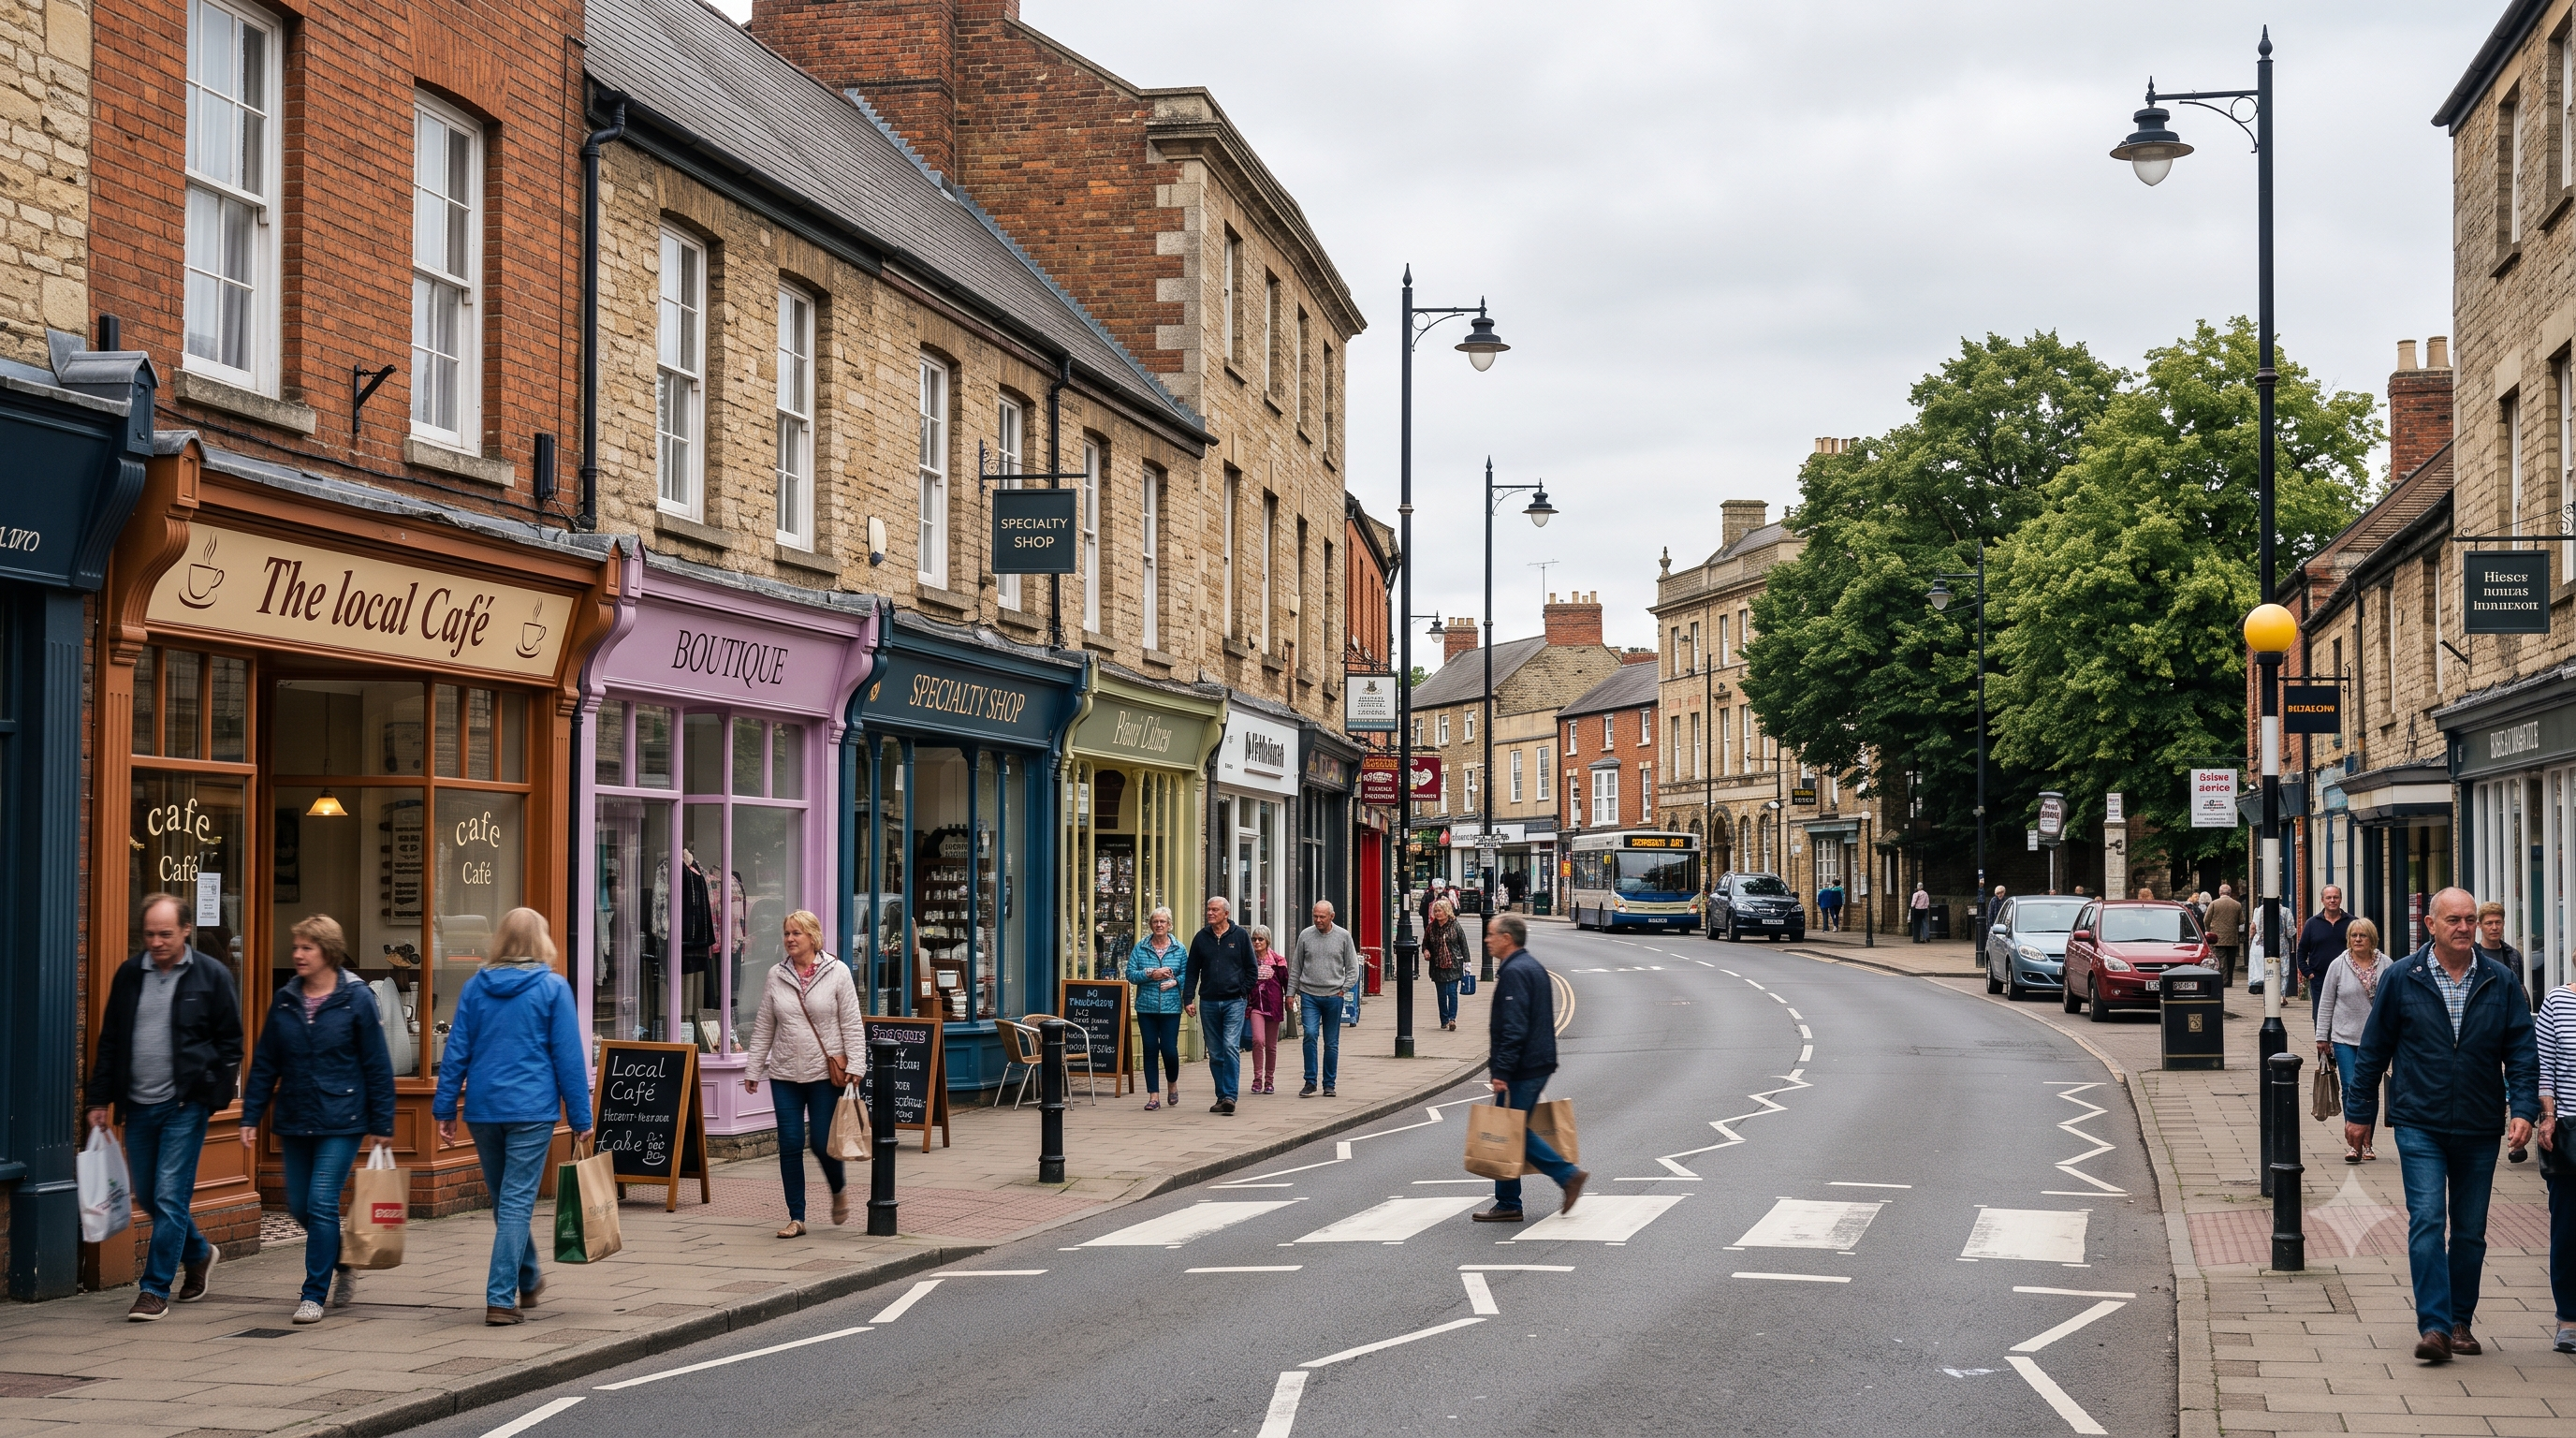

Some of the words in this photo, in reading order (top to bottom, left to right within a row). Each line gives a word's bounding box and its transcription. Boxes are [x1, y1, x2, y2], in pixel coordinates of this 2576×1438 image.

[1001, 518, 1068, 529] SPECIALTY
[1014, 536, 1055, 549] SHOP
[256, 556, 327, 622] The
[331, 569, 418, 636] local
[420, 587, 495, 658] Café
[671, 629, 789, 689] BOUTIQUE
[909, 673, 989, 717] SPECIALTY
[986, 688, 1026, 723] SHOP
[148, 798, 210, 842] cafe
[456, 811, 501, 848] cafe
[159, 855, 198, 882] Café
[462, 860, 491, 885] Café
[611, 1055, 666, 1078] Local
[610, 1080, 656, 1107] Café
